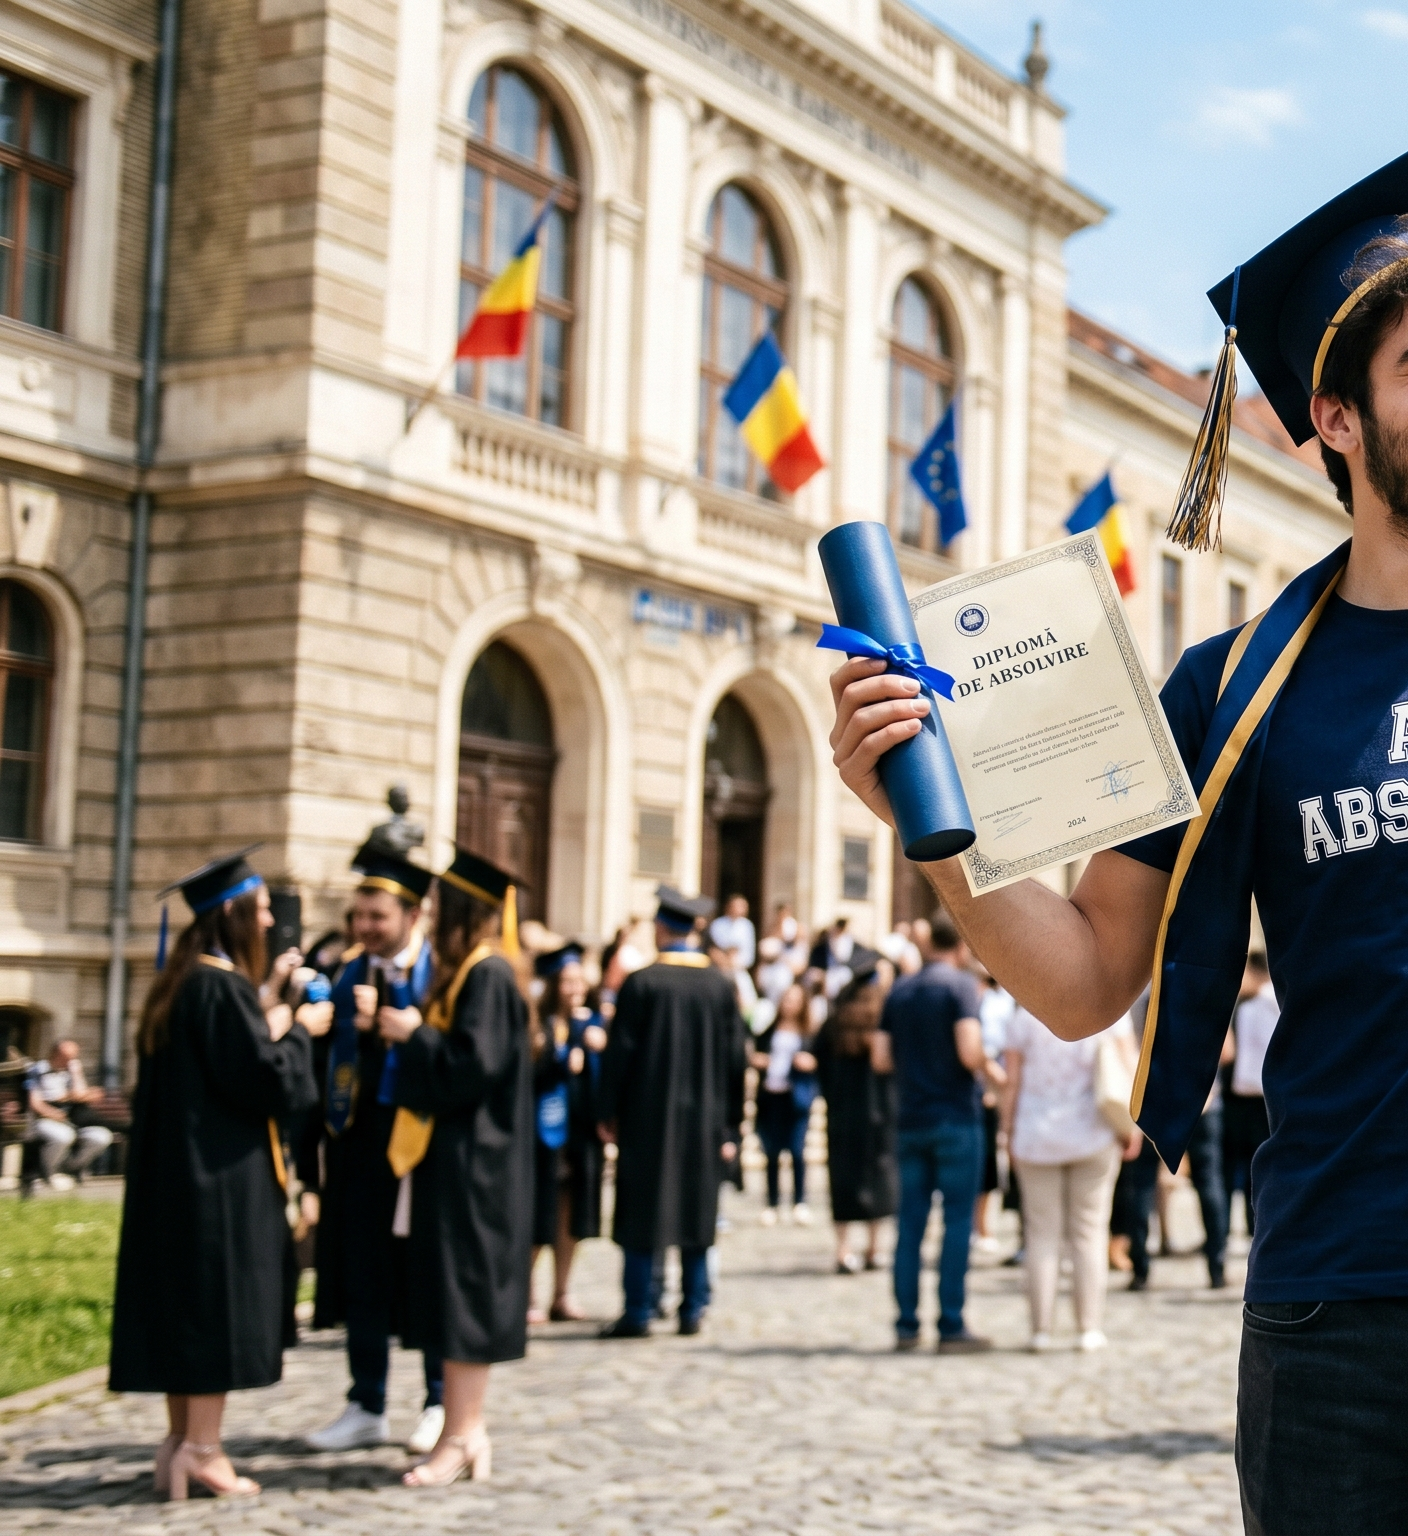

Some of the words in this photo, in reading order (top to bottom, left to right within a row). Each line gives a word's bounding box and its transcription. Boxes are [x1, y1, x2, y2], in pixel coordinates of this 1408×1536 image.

[957, 678, 984, 697] DE
[989, 642, 1089, 688] ABSOLVIRE
[972, 627, 1058, 670] DIPLOMĂ
[1067, 816, 1087, 828] 2024
